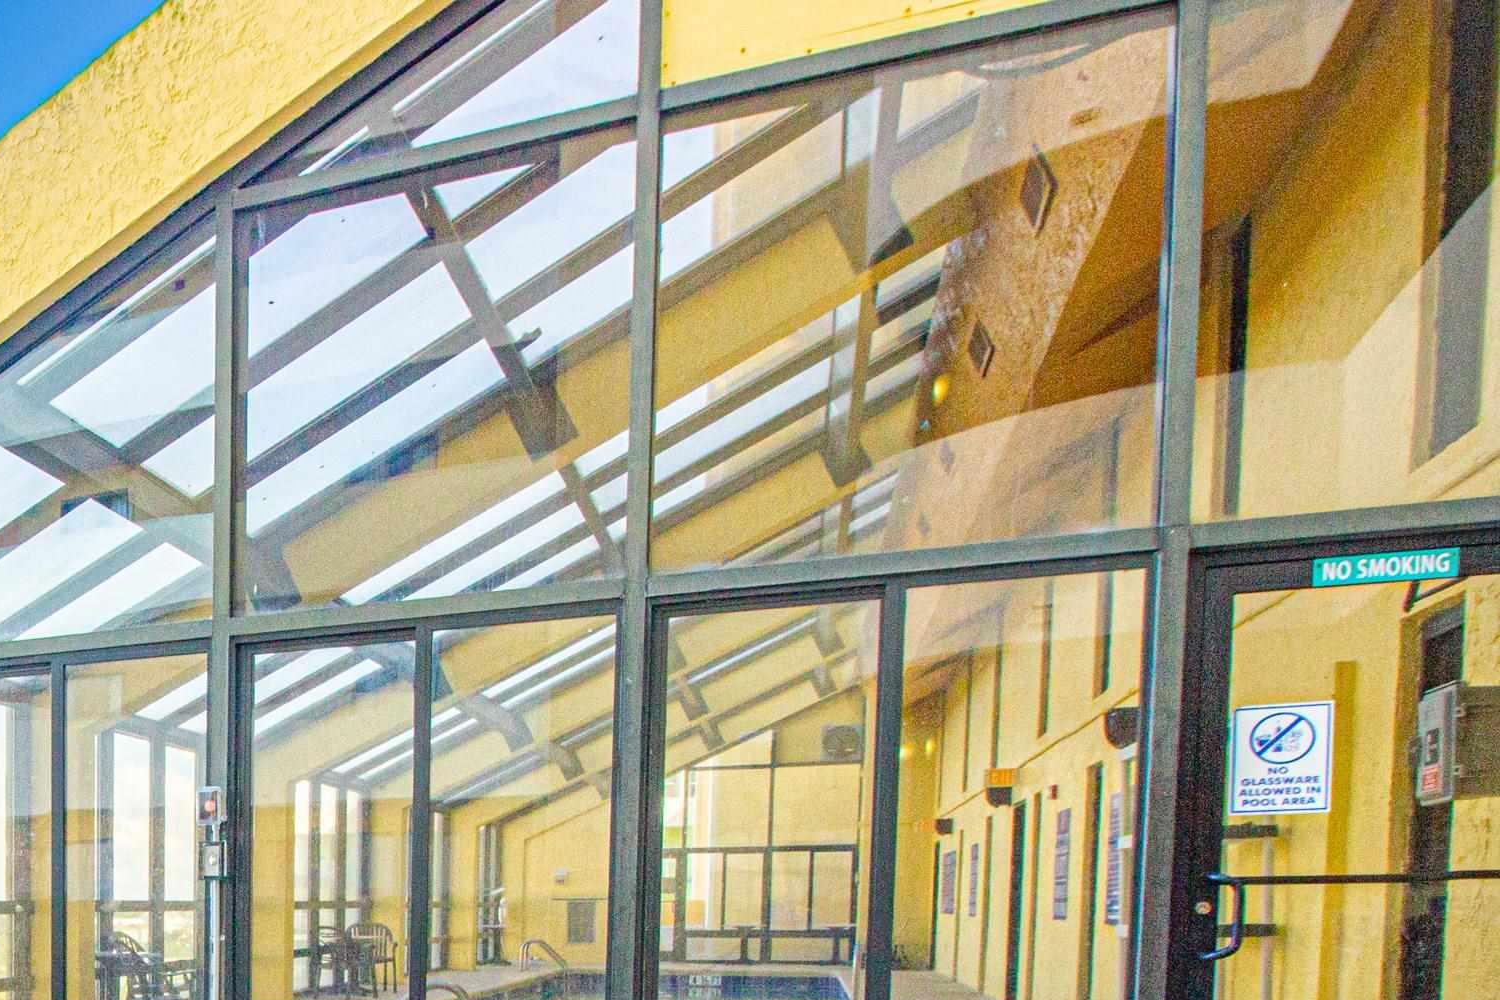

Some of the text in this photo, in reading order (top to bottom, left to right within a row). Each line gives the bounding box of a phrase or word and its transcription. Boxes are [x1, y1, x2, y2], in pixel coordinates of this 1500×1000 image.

[1322, 552, 1451, 581] NO SMOKING
[1267, 766, 1289, 775] NO
[1240, 775, 1320, 787] GLASSWARE
[1238, 785, 1321, 797] ALLOWED IN
[1241, 796, 1316, 807] POOL AREA
